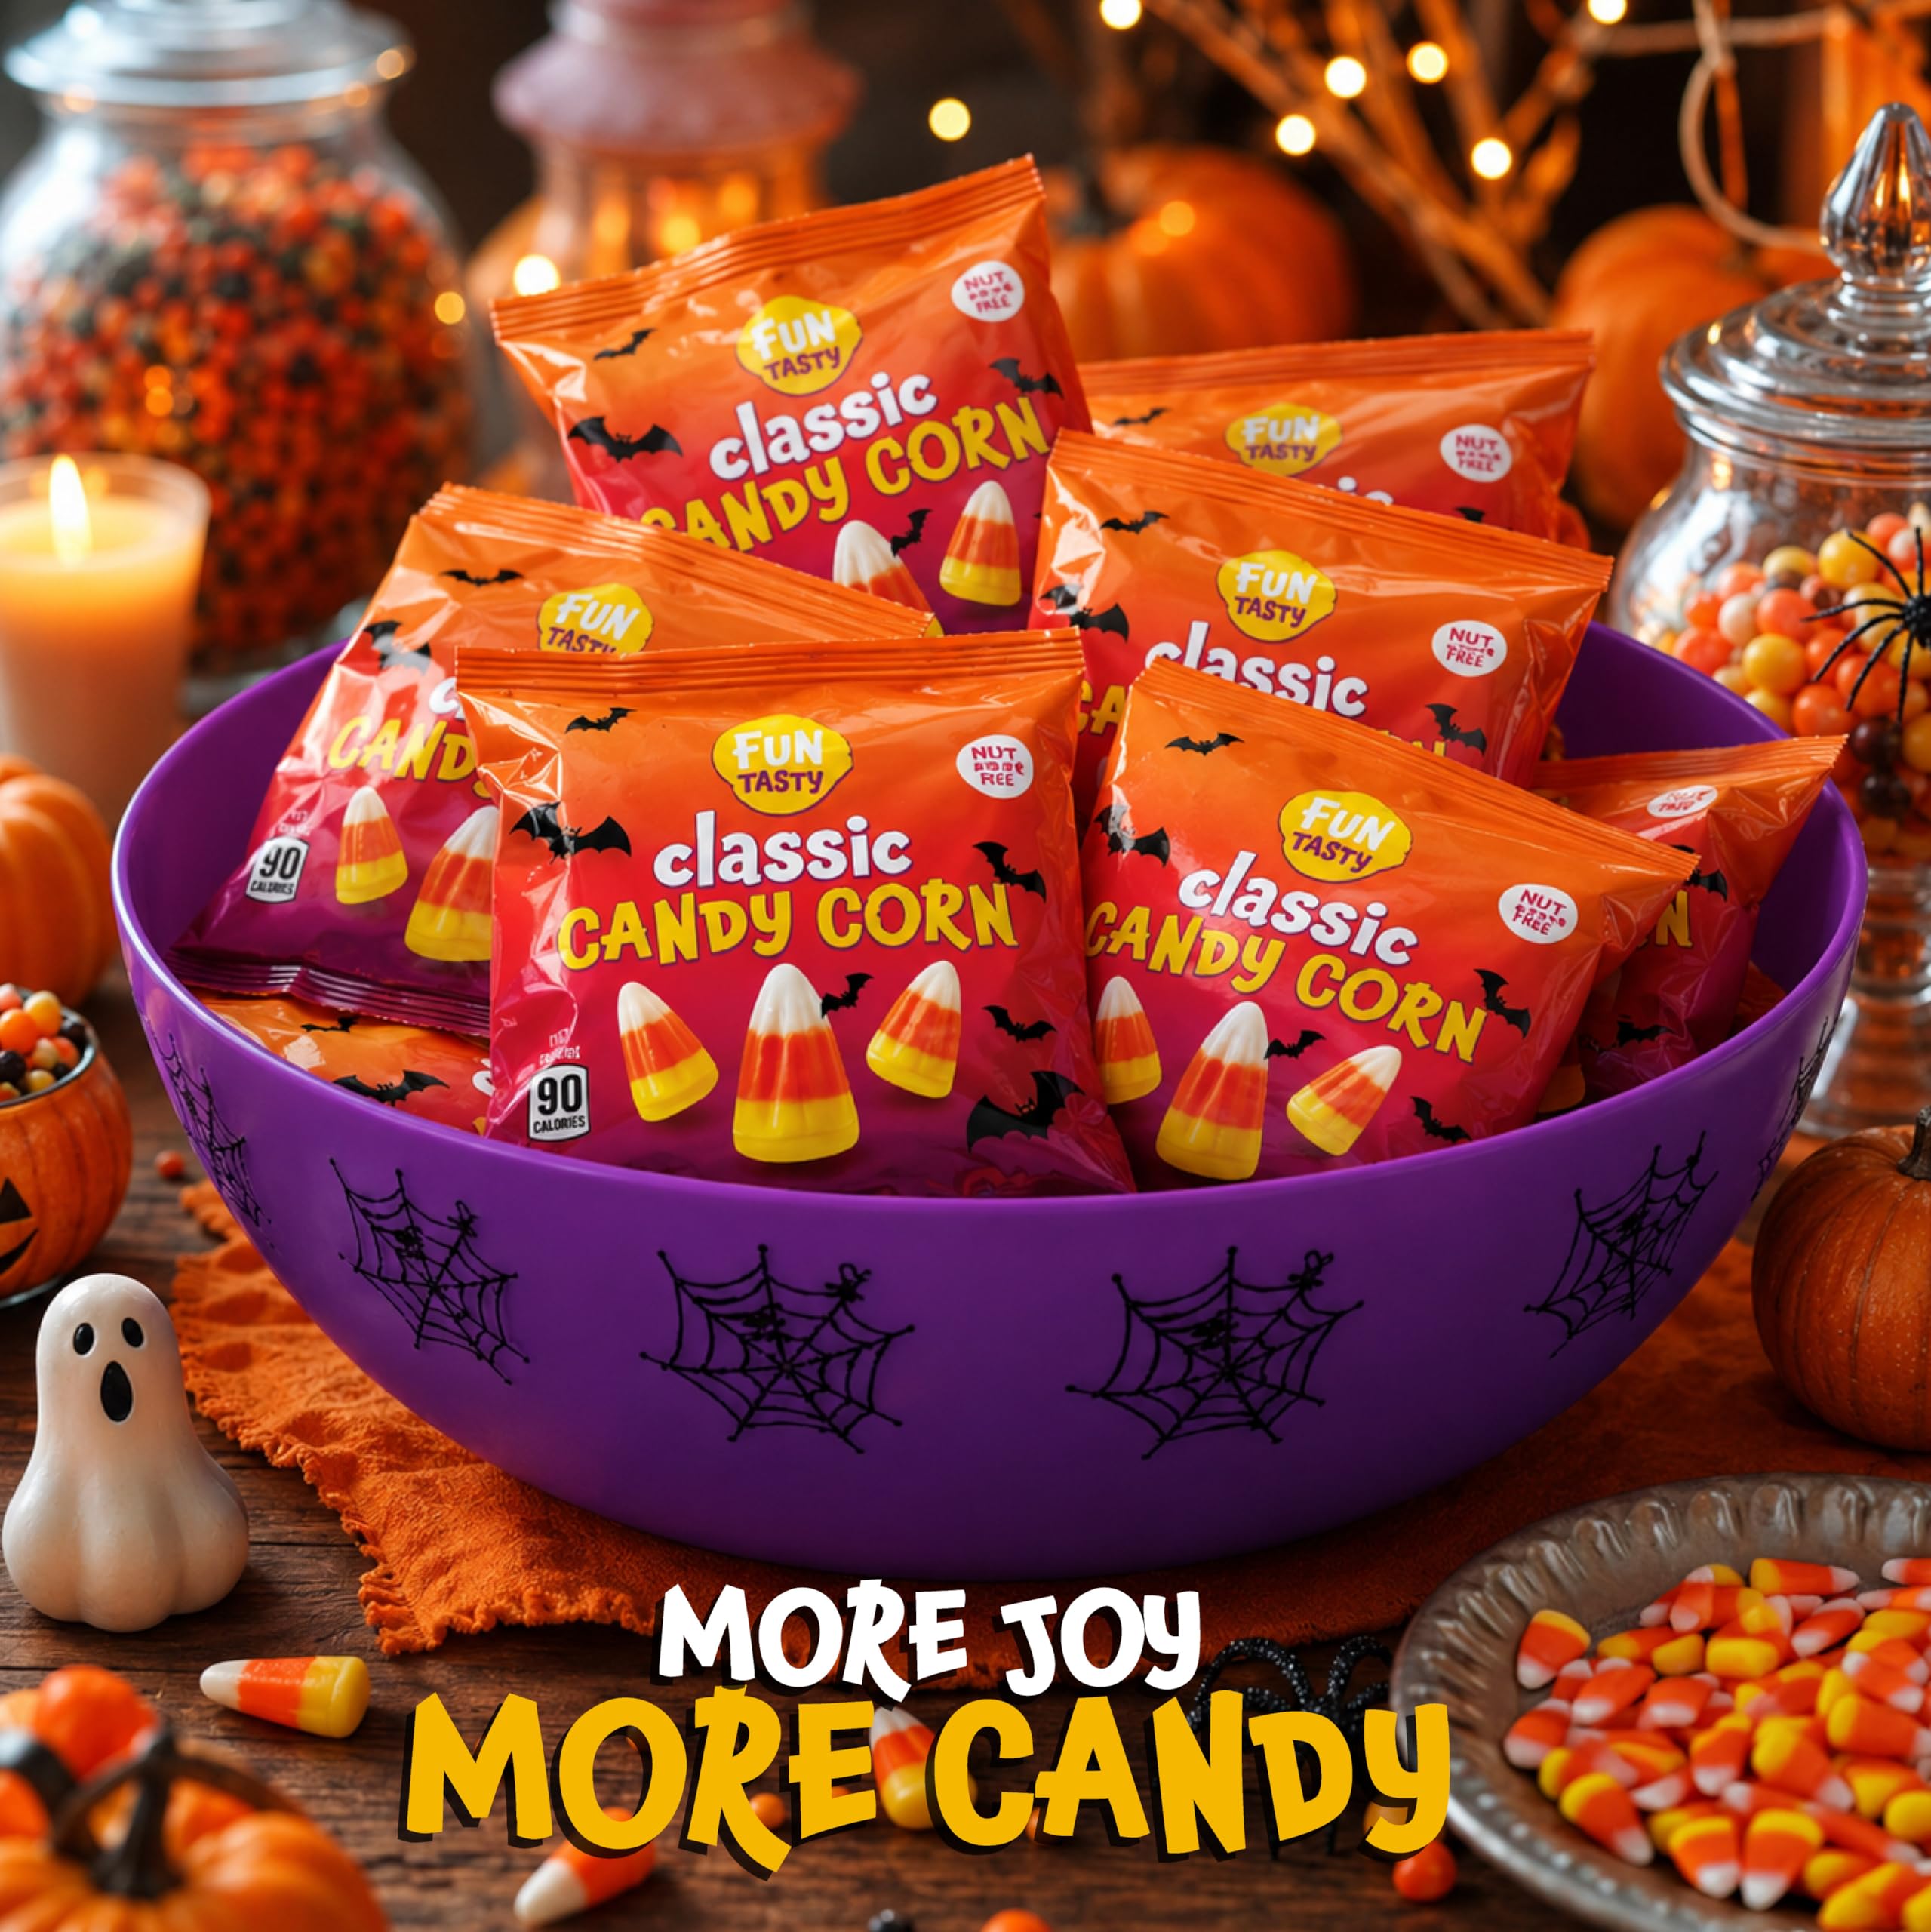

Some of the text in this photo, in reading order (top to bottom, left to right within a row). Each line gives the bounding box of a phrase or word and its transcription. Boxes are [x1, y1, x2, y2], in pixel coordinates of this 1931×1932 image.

[750, 309, 836, 361] FUN
[763, 346, 841, 380] TASTY
[709, 371, 938, 481] classic
[1241, 414, 1320, 444] FUN
[1456, 434, 1498, 451] NUT
[865, 397, 1052, 496] CORN
[1245, 443, 1317, 463] TASTY
[1235, 561, 1318, 604] FUN
[555, 593, 640, 641] FUN
[1235, 596, 1306, 628] TASTY
[1449, 627, 1494, 648] NUT
[732, 729, 823, 769] FUN
[971, 746, 1017, 761] NUT
[736, 769, 823, 794] TASTY
[1300, 797, 1395, 851] FUN
[260, 847, 301, 879] 90
[653, 810, 912, 888] classic
[1293, 831, 1373, 873] TASTY
[1178, 851, 1419, 966] classic
[1520, 888, 1567, 915] NUT
[558, 878, 1019, 971] CANDY CORN
[1085, 900, 1487, 1064] CANDY CORN
[537, 1074, 583, 1115] 90
[533, 1115, 586, 1134] CALORIES
